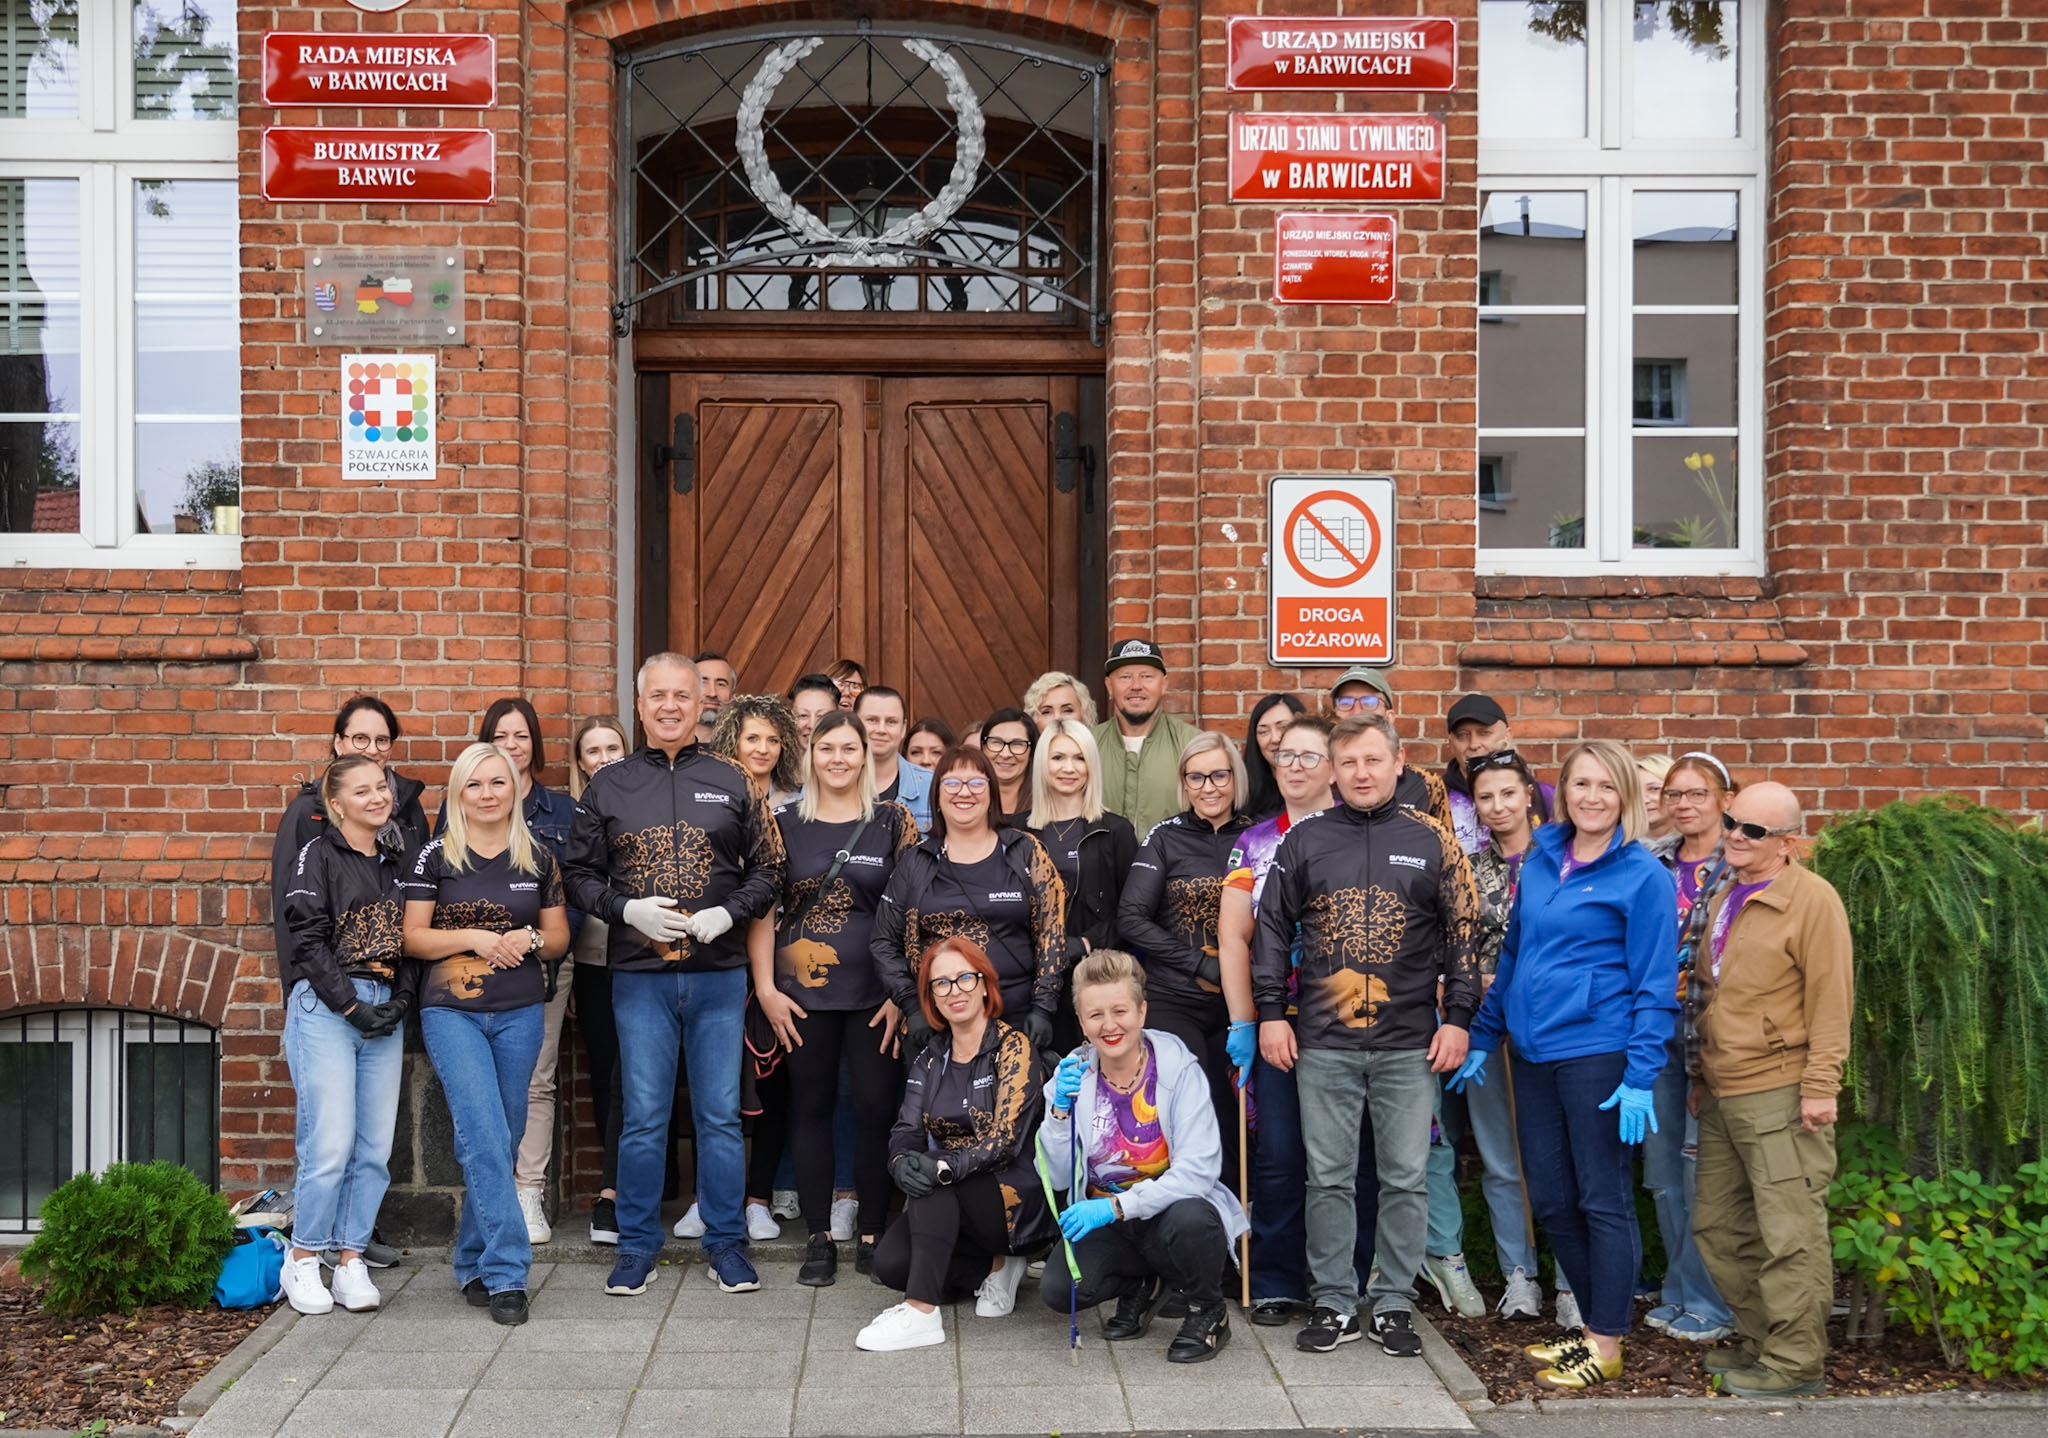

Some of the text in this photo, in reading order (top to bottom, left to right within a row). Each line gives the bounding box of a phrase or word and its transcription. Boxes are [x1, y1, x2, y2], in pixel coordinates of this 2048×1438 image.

[1262, 31, 1426, 53] URZĄD MIEJSKI
[298, 46, 456, 68] RADA MIEJSKA
[1275, 57, 1412, 75] w BARWICACH
[308, 72, 447, 91] w BARWICACH
[1239, 125, 1435, 153] URZĄD STANU CYWILNEGO
[314, 142, 441, 161] BURMISTRZ
[338, 167, 416, 186] BARWIC
[1262, 162, 1412, 189] w BARWICACH
[1282, 230, 1391, 242] URZĄD MIEJSKI CZYNNY:
[348, 449, 429, 460] SZWAJCARIA
[348, 460, 429, 472] POŁCZYŃSKA
[1299, 607, 1364, 623] DROGA
[1280, 630, 1382, 648] POŻAROWA
[414, 838, 445, 875] BARWIC
[989, 891, 1022, 899] BARWICE
